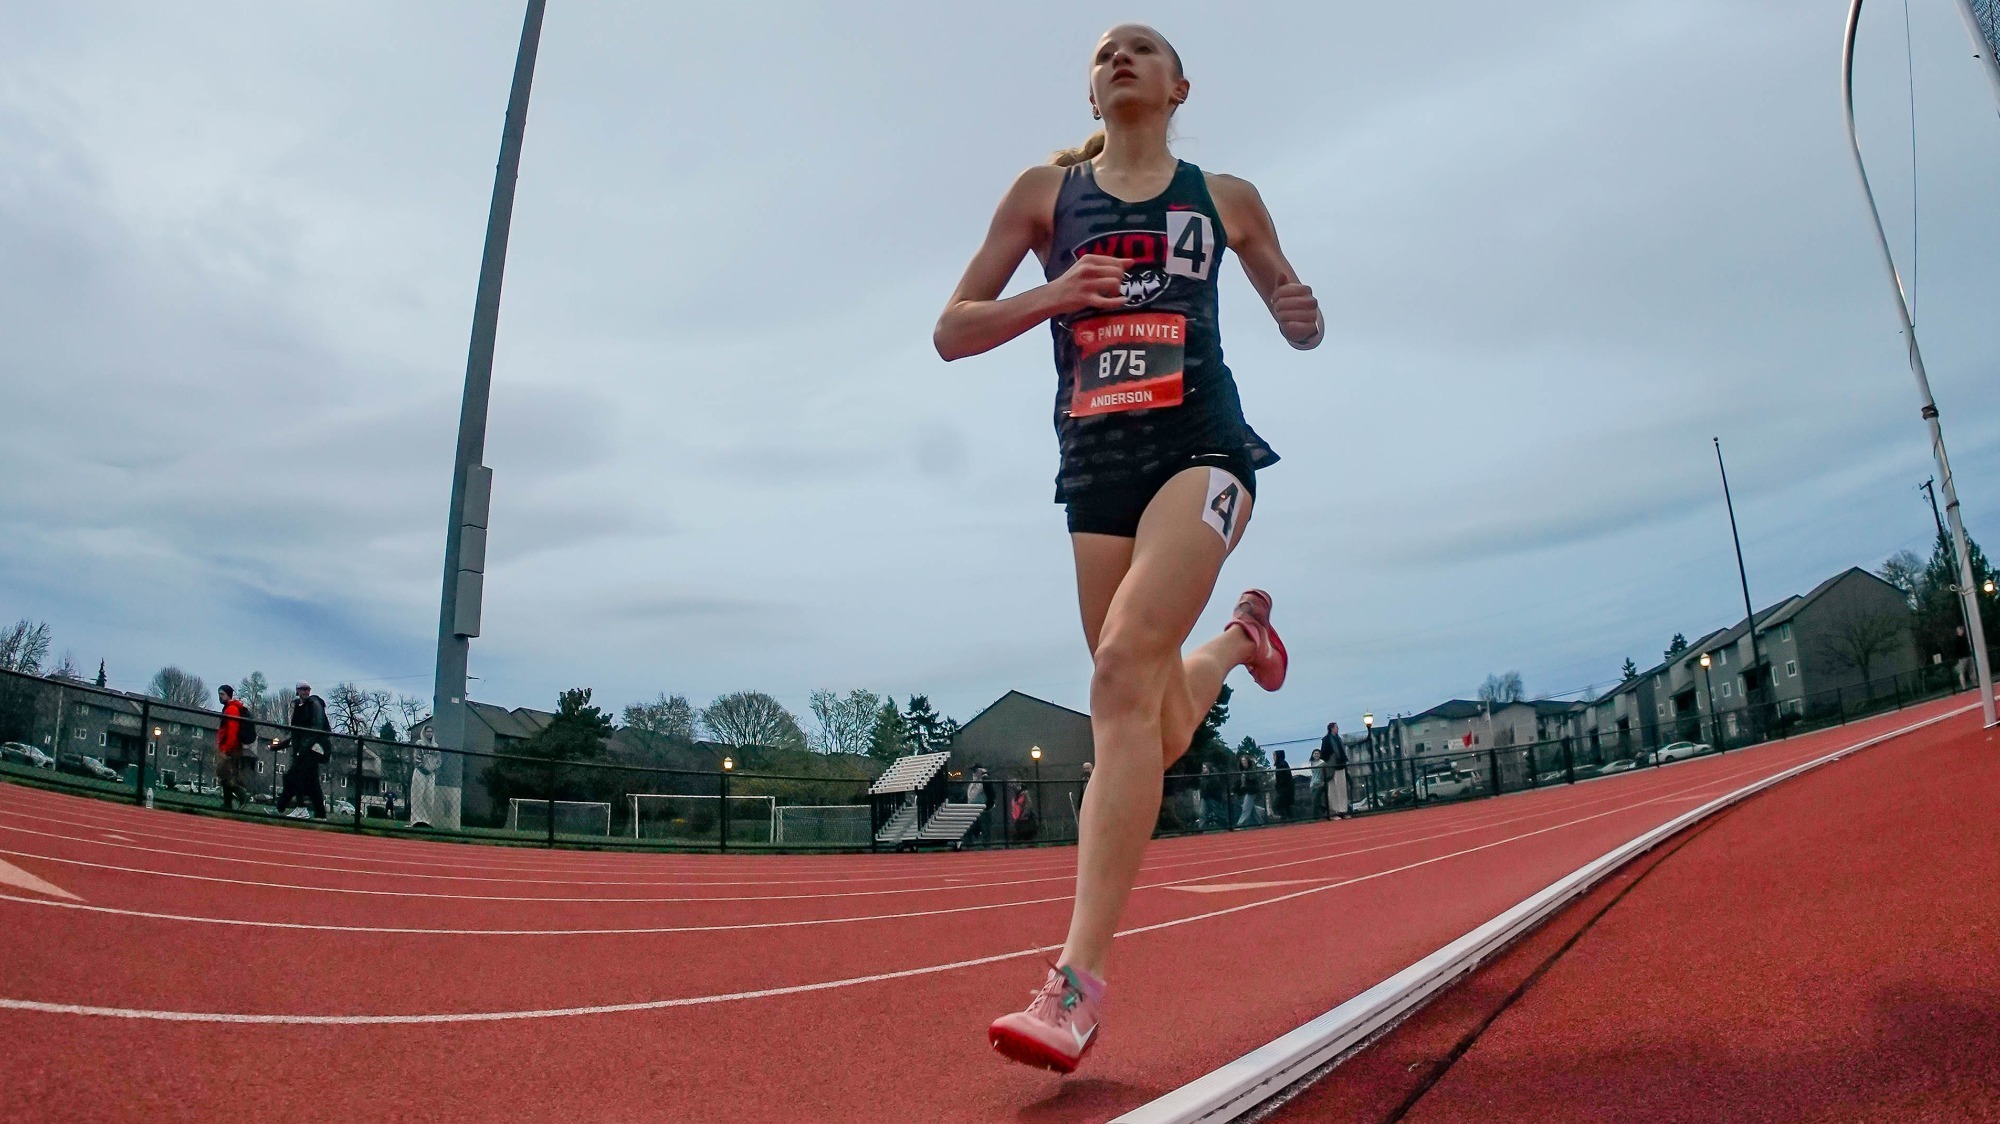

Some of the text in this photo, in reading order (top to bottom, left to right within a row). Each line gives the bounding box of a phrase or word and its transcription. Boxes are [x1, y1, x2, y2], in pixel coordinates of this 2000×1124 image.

[1173, 216, 1206, 273] 4
[1097, 323, 1179, 341] PNW INVITE
[1098, 349, 1146, 379] 875
[1090, 390, 1153, 409] ANDERSON
[1210, 481, 1239, 538] 4
